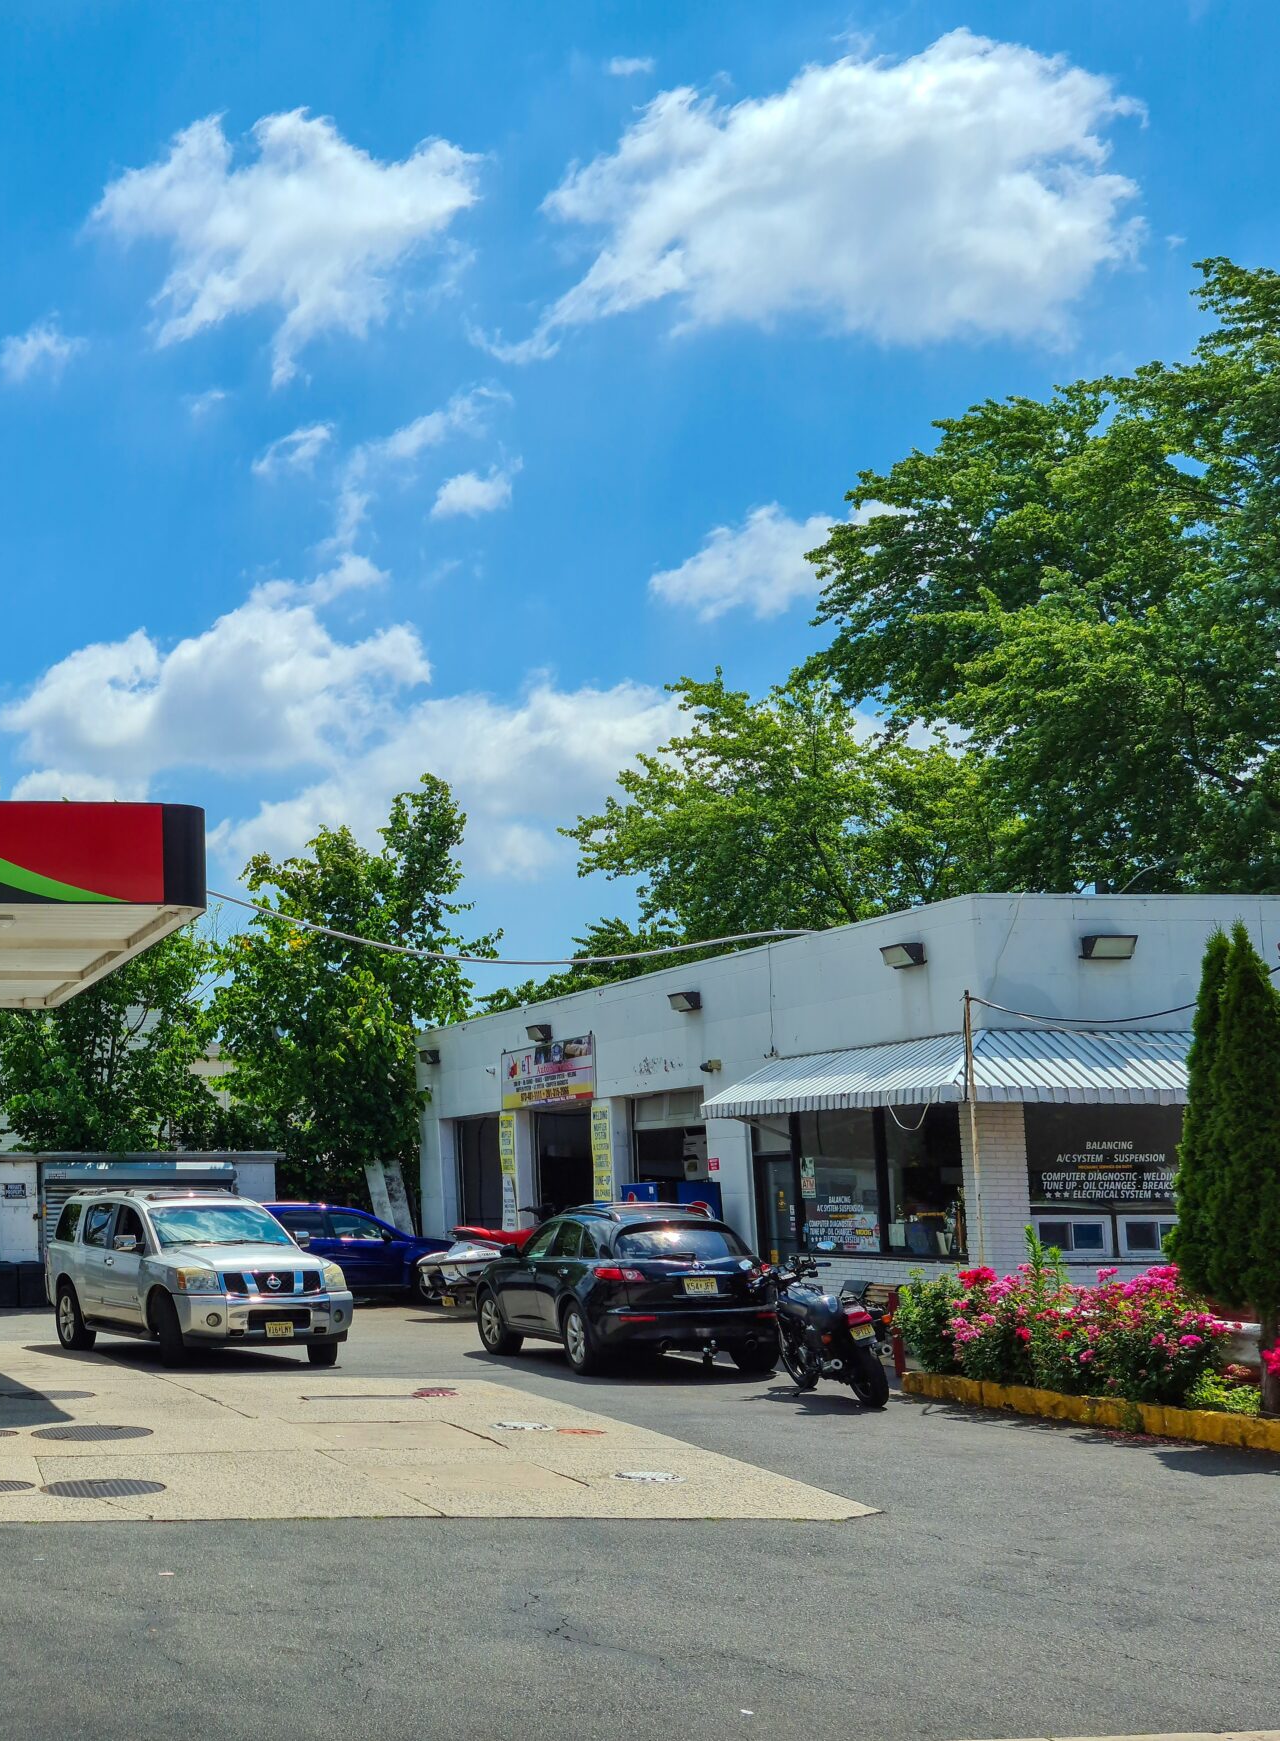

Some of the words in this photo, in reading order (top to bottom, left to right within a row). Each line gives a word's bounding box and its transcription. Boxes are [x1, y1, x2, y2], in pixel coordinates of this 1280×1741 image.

[1086, 1141, 1133, 1150] BALANCING
[1056, 1154, 1071, 1162] A/C
[1072, 1154, 1103, 1162] SYSTEM
[1114, 1153, 1166, 1162] SUSPENSION
[1042, 1173, 1086, 1181] COMPUTER
[1088, 1173, 1138, 1181] DIAGNOSTIC
[1098, 1182, 1136, 1190] CHANGES
[1143, 1181, 1174, 1189] BREAKS
[1073, 1190, 1118, 1198] ELECTRICAL
[1120, 1190, 1151, 1198] SYSTEM
